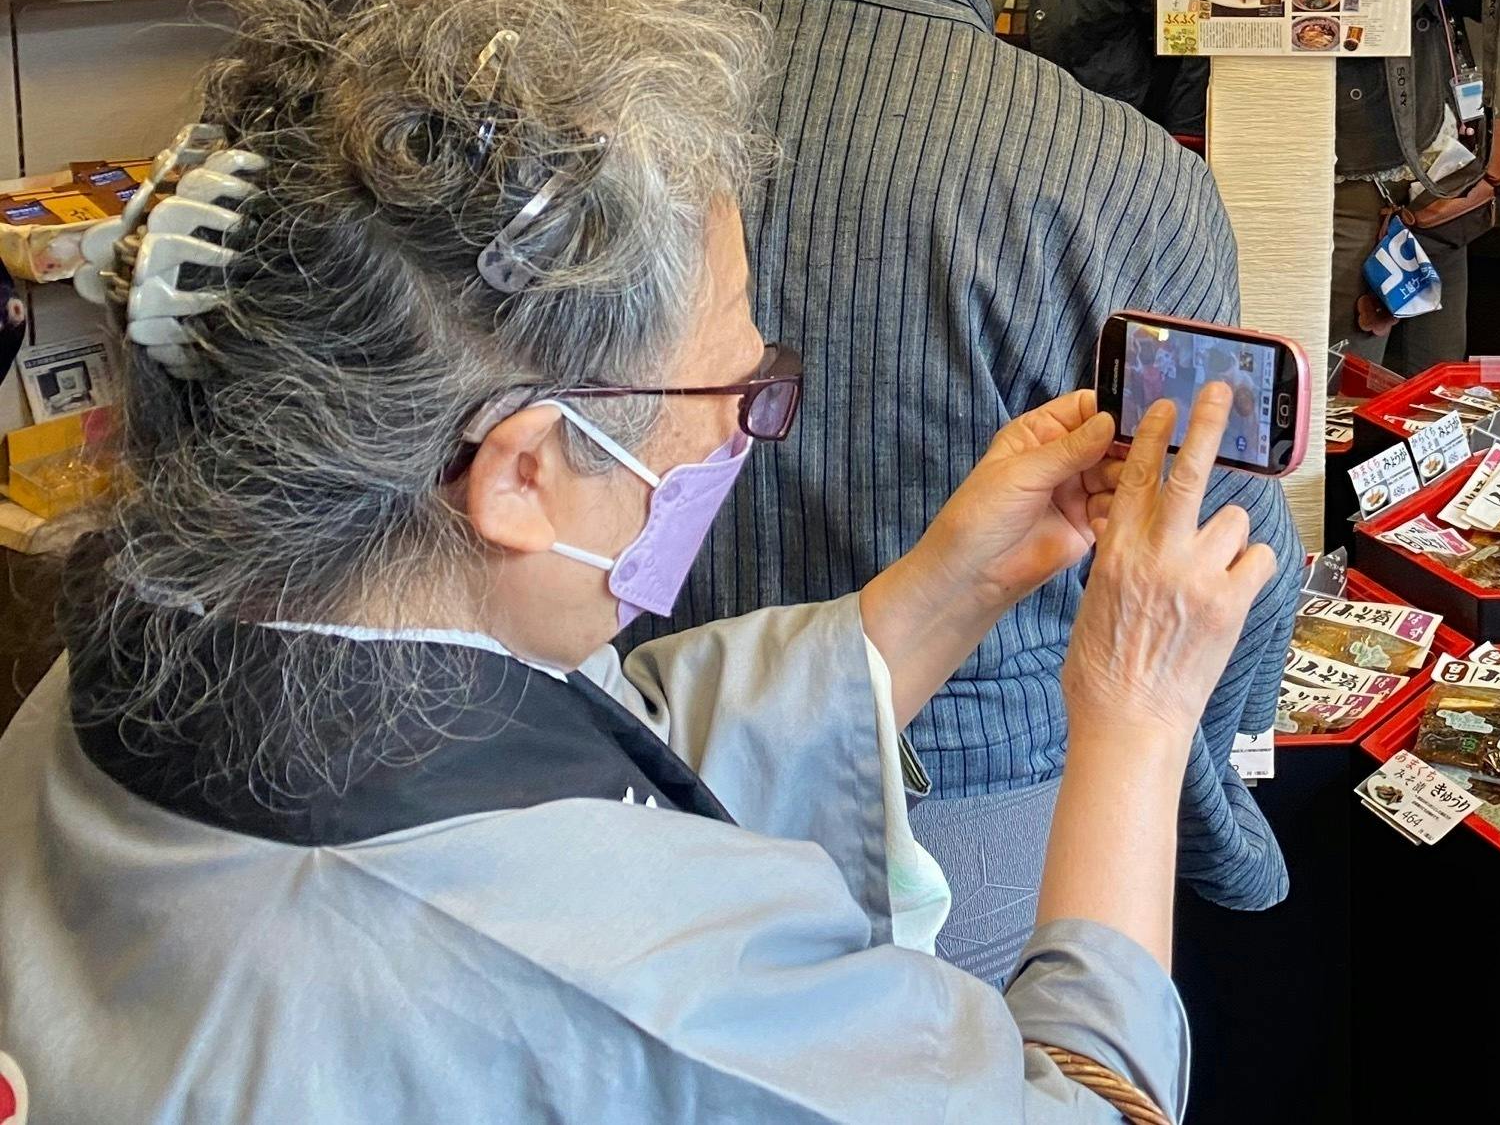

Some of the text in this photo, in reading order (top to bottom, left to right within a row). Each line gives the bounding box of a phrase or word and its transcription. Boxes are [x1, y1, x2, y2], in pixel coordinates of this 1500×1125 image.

[1111, 358, 1120, 395] docomo
[1382, 447, 1408, 470] みょうが
[1332, 603, 1392, 626] みそ漬
[1407, 612, 1424, 639] なす
[1296, 660, 1360, 692] みそ漬
[1447, 663, 1467, 682] 甘口
[1395, 752, 1437, 783] あまくち
[1430, 782, 1471, 813] きゅうり
[1402, 810, 1423, 827] 464
